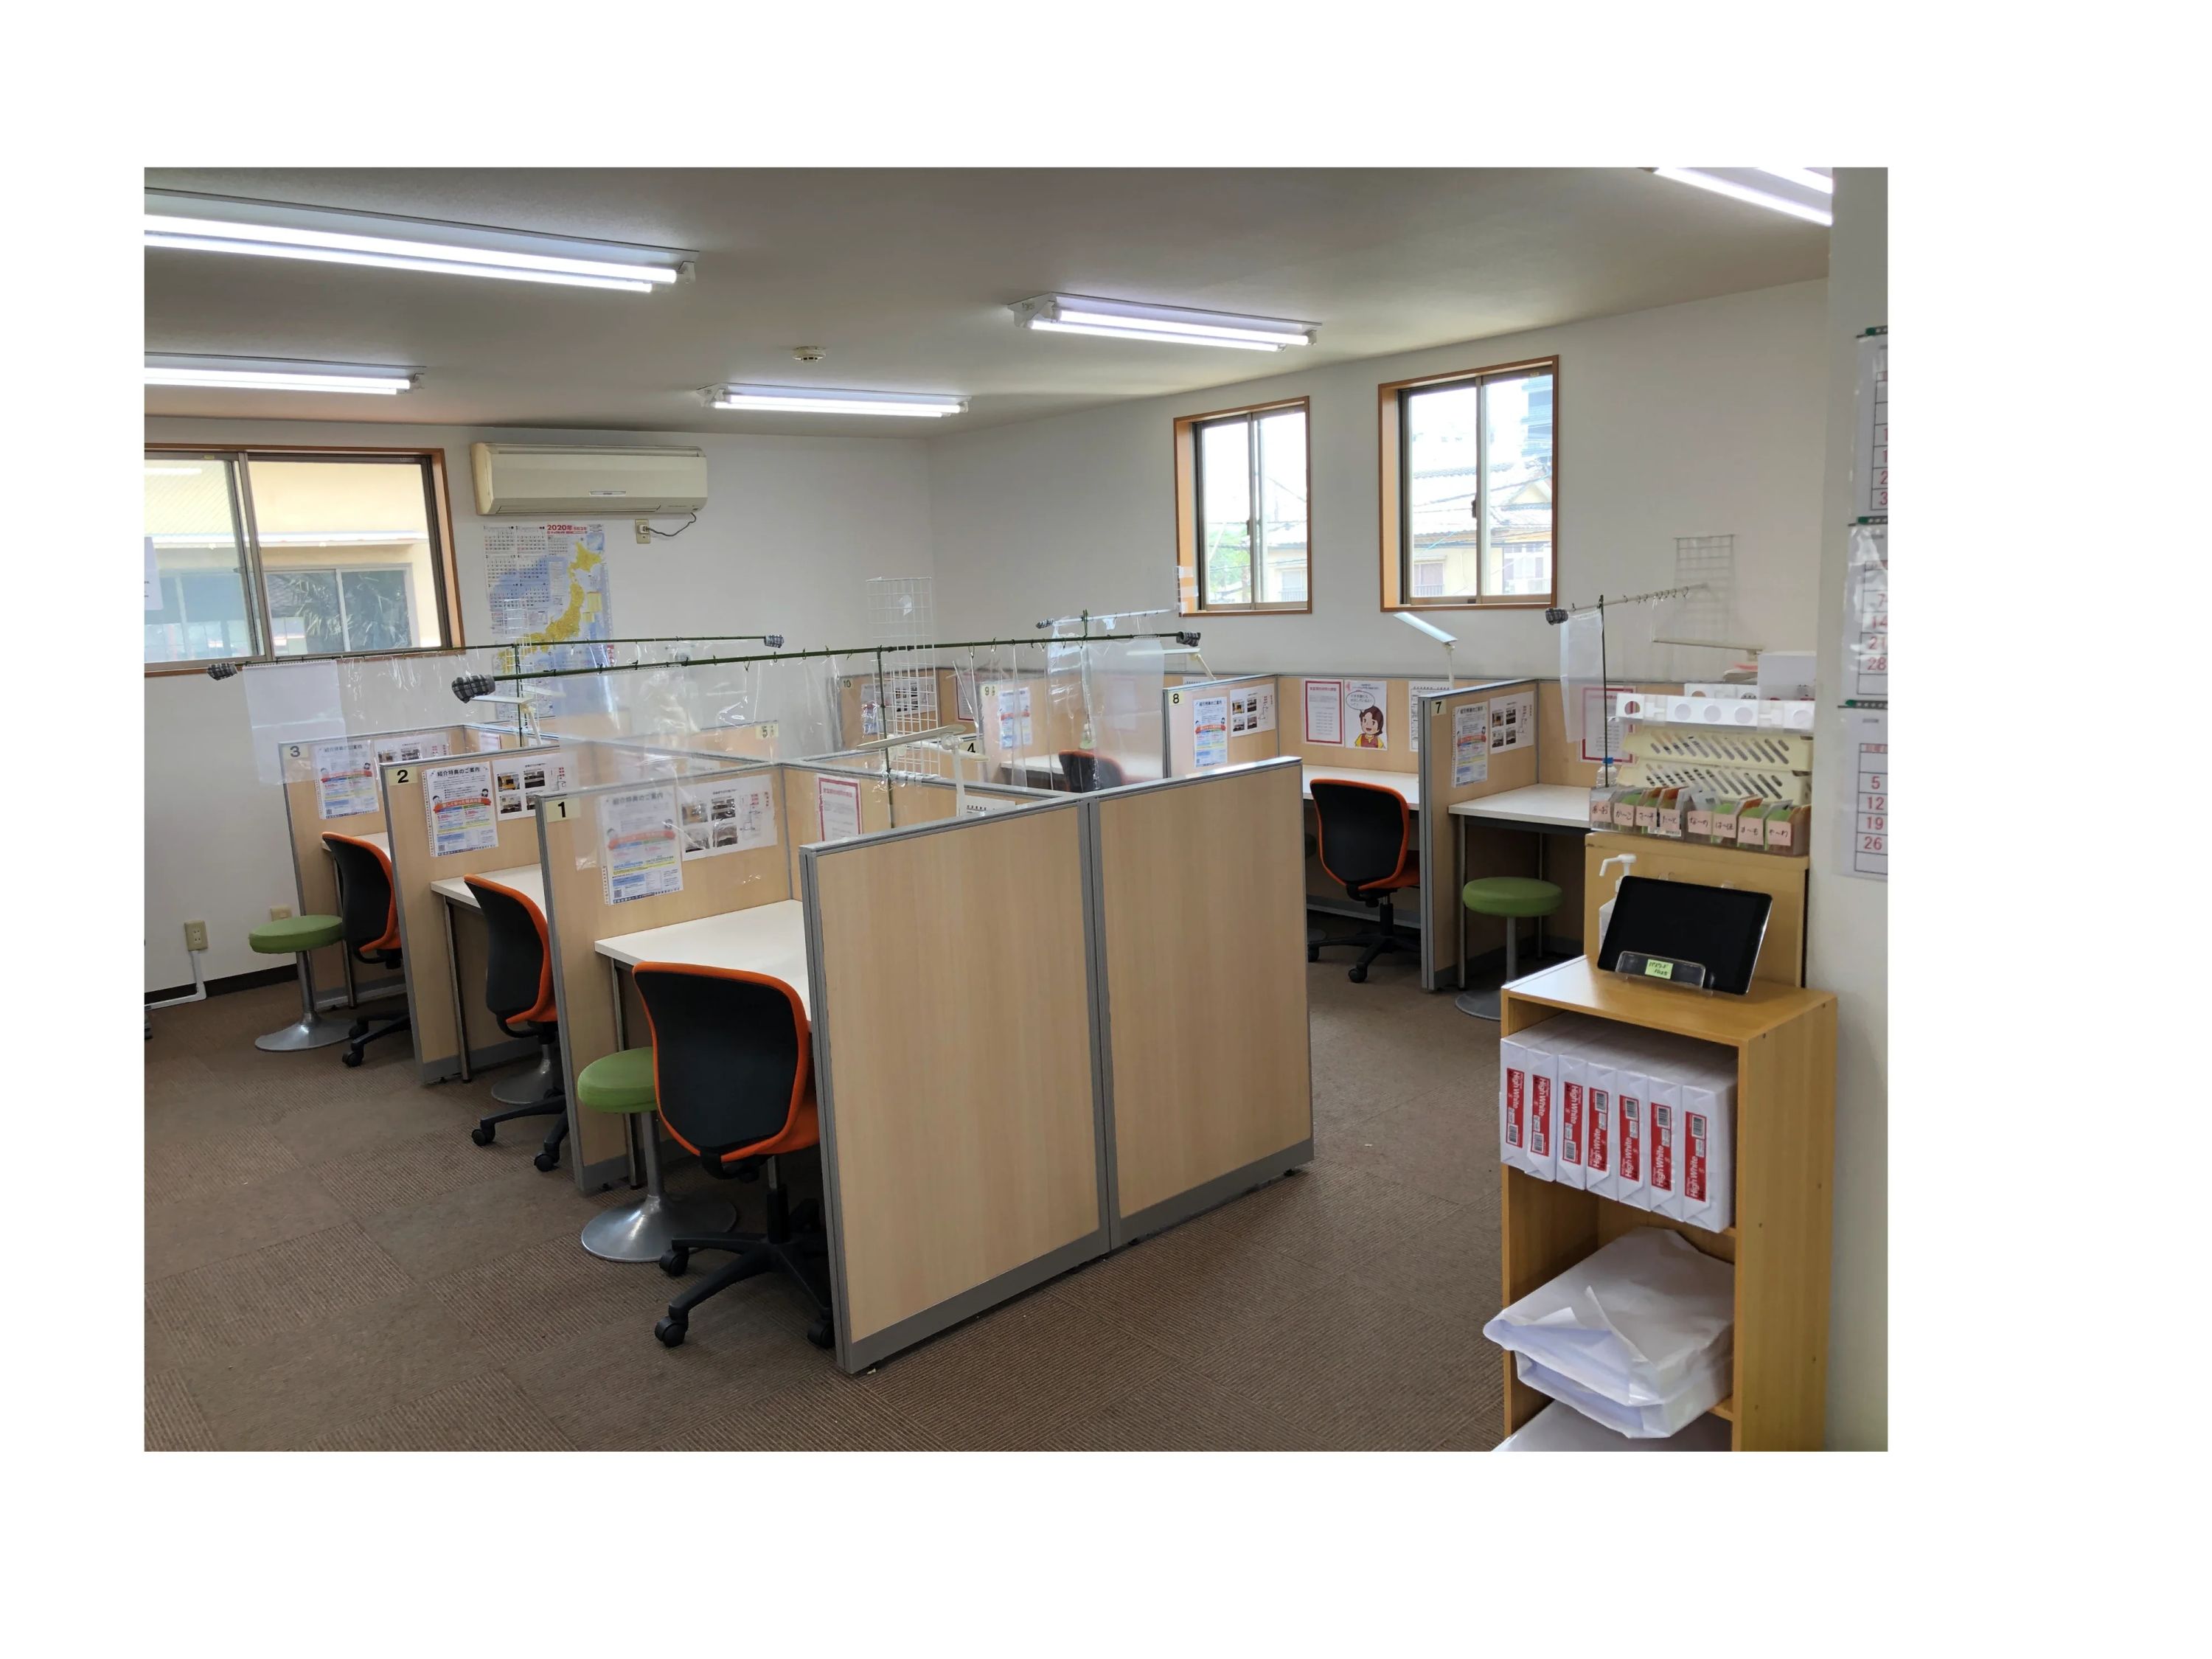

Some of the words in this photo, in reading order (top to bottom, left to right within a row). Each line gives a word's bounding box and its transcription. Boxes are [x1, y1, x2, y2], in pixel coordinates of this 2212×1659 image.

[1867, 656, 1887, 671] 28
[843, 680, 852, 688] 10
[1172, 693, 1180, 704] 8
[1436, 701, 1442, 714] 7
[290, 745, 301, 758] 3
[397, 769, 409, 784] 2
[1871, 776, 1880, 790] 5
[558, 801, 566, 818] 1
[1868, 796, 1885, 810] 12
[1867, 817, 1883, 830] 19
[1865, 836, 1882, 850] 26
[1570, 1085, 1578, 1102] High
[1593, 1150, 1601, 1167] High
[1625, 1159, 1634, 1177] High
[1657, 1168, 1665, 1187] High
[1691, 1178, 1700, 1197] High
